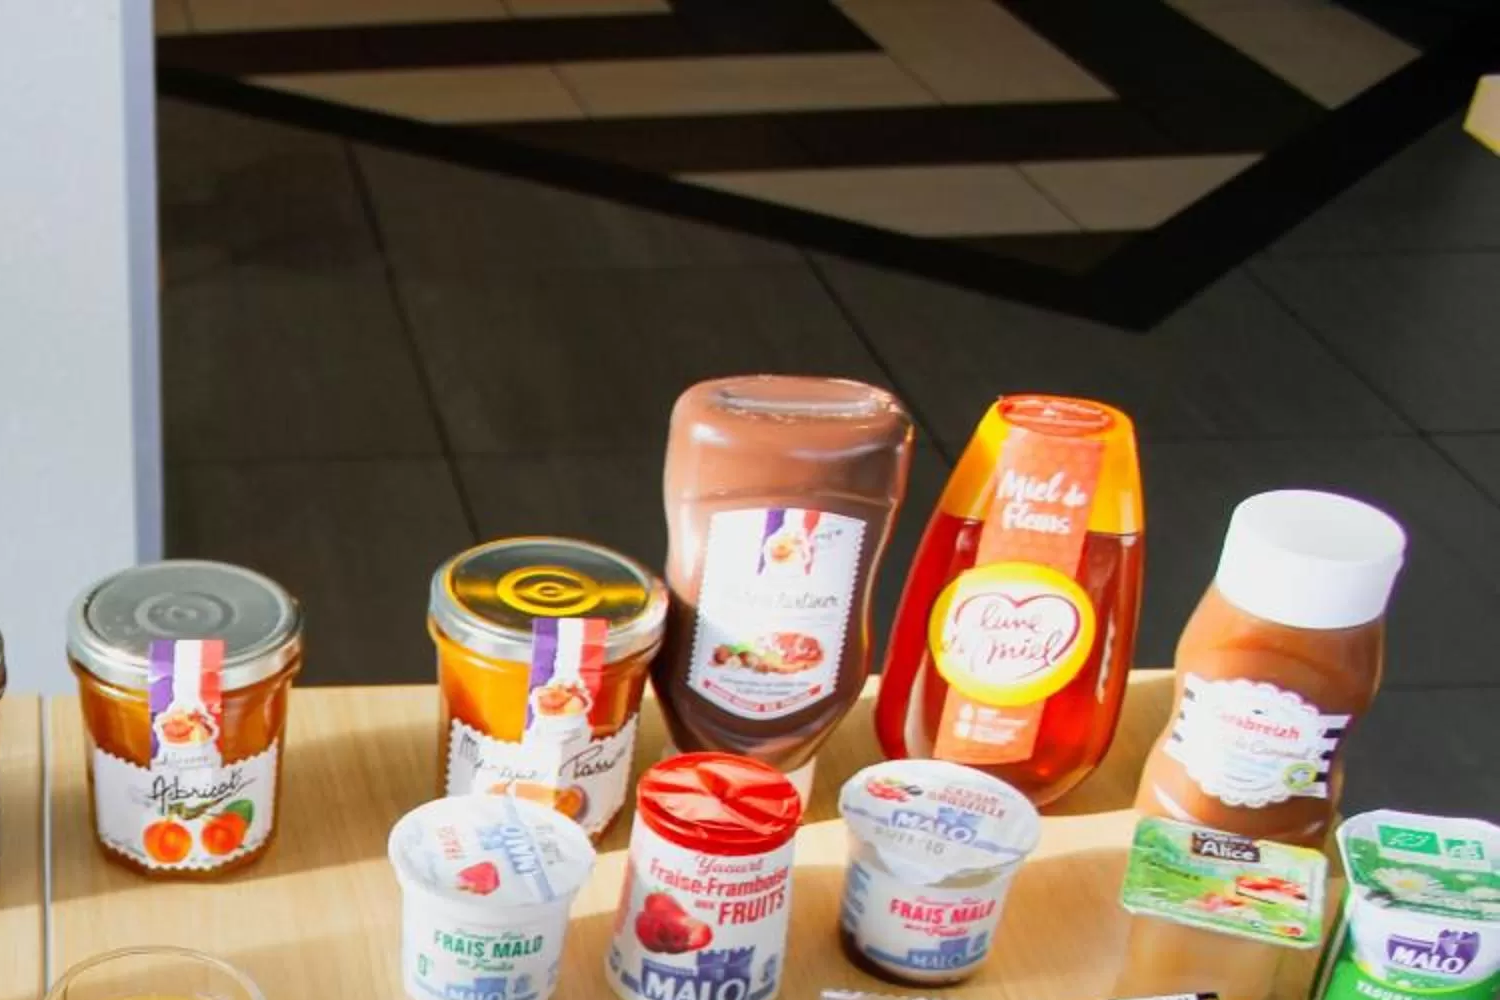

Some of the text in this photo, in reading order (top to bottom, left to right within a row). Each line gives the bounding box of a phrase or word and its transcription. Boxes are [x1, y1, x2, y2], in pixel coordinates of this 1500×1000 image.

[996, 468, 1066, 503] Miel
[147, 768, 243, 815] Abricot
[895, 812, 973, 844] MALO
[1200, 840, 1256, 861] Alice
[717, 886, 786, 926] FRUITS
[890, 898, 943, 925] FRAIS
[434, 930, 485, 958] FRAIS
[492, 934, 544, 958] MALO
[1390, 945, 1465, 974] MALO
